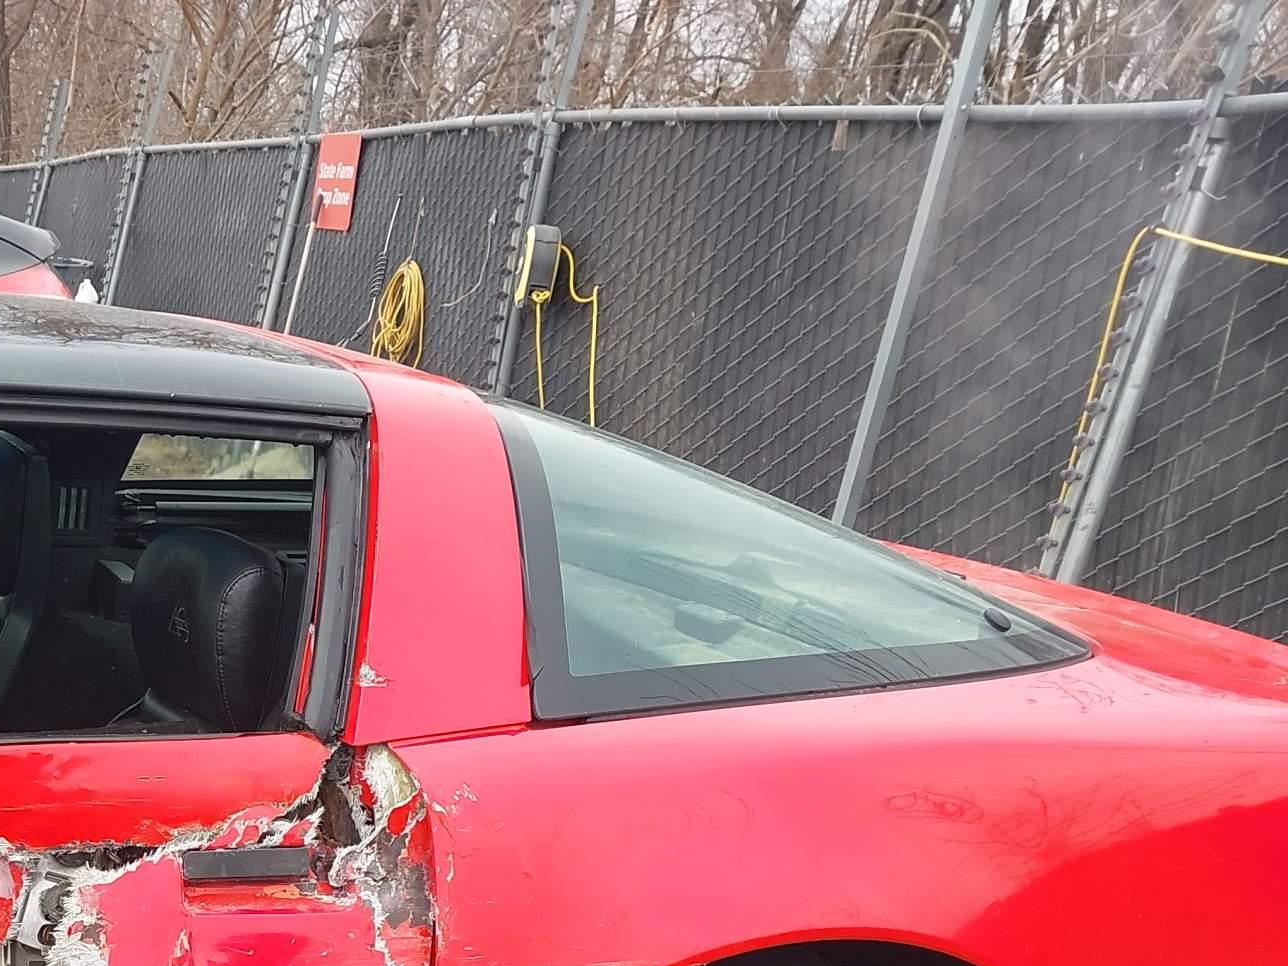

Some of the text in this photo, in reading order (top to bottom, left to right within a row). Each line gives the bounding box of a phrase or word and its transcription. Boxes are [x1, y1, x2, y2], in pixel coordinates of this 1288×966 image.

[318, 162, 355, 179] State Farm
[317, 187, 351, 208] Dop Zone
